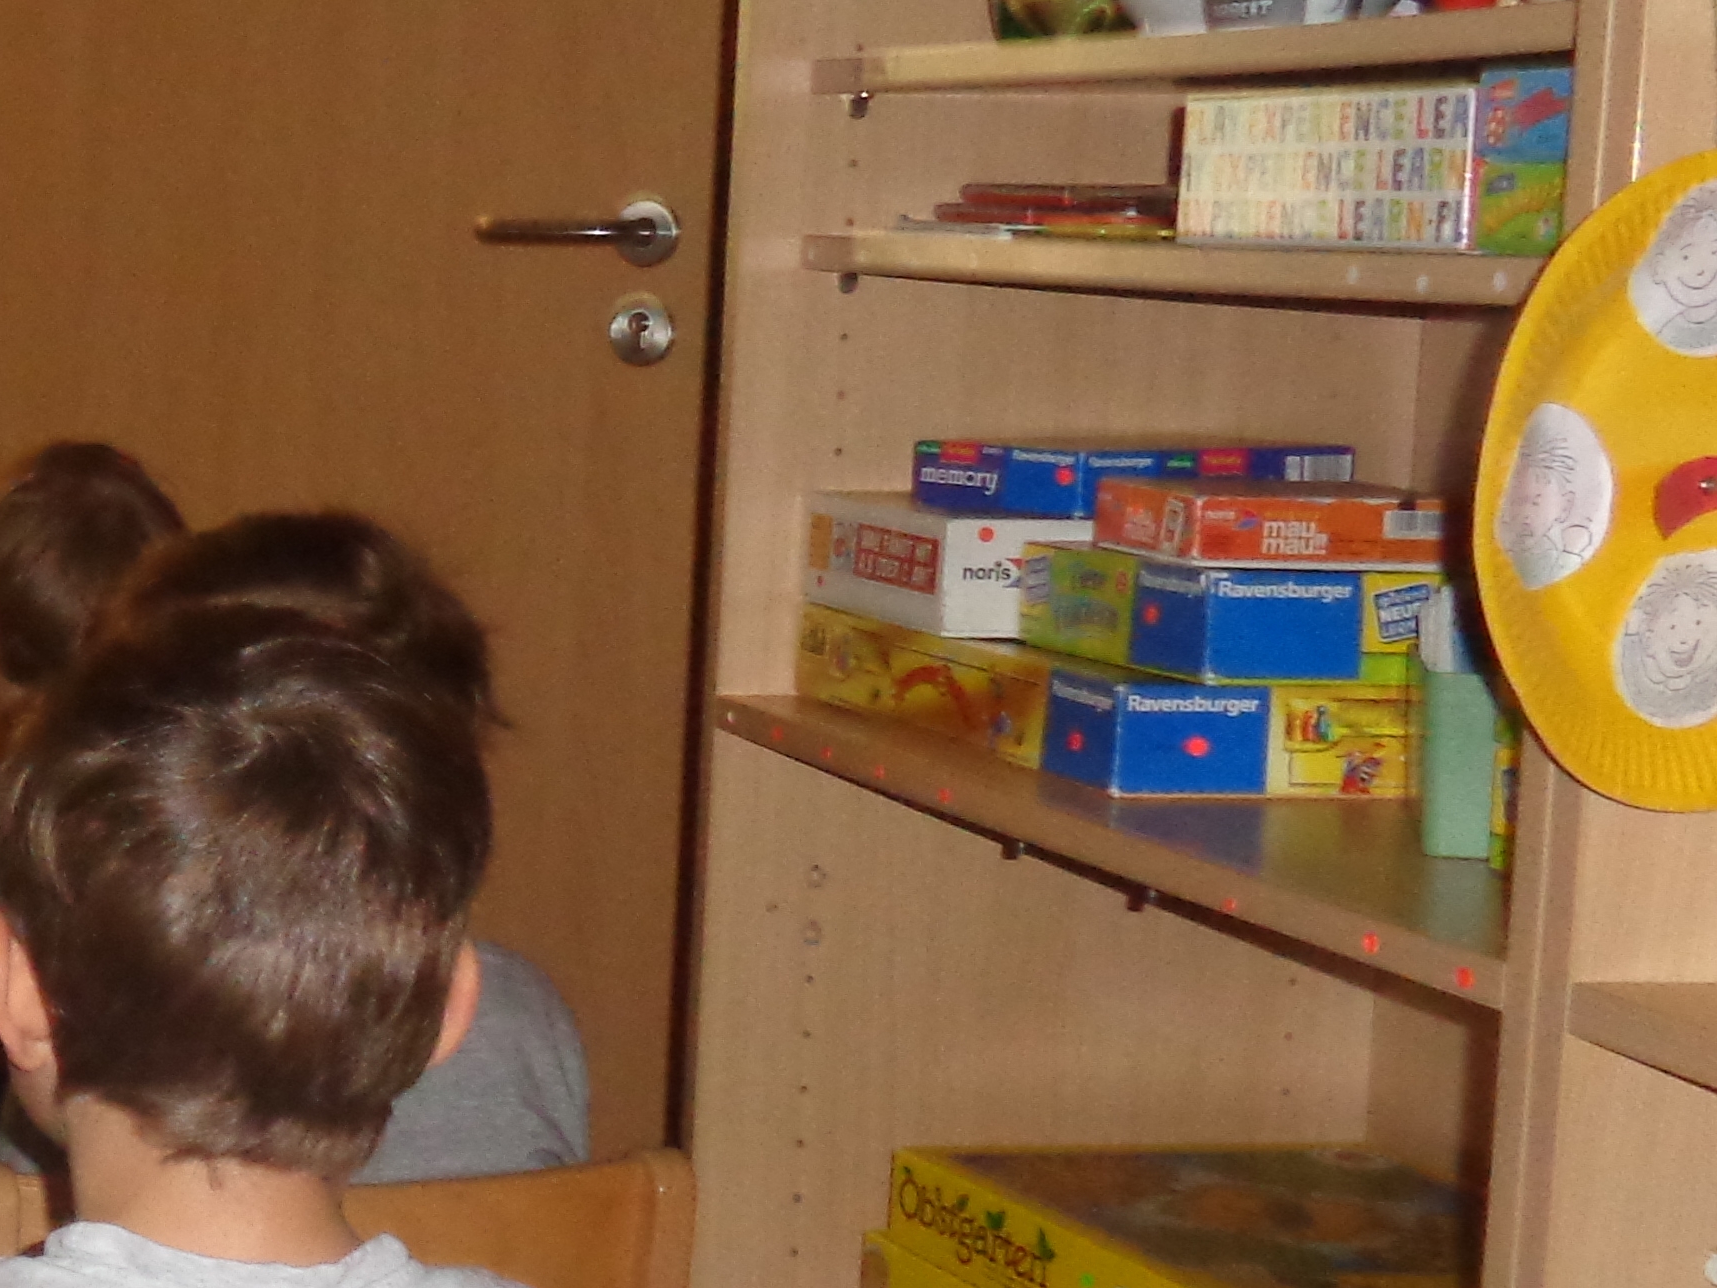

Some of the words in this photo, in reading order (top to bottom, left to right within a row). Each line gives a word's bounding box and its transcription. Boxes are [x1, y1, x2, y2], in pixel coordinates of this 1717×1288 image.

[919, 465, 999, 495] memory
[962, 560, 1013, 582] noris
[1218, 580, 1353, 603] Ravensburger
[1127, 695, 1260, 717] Ravensburger
[898, 1173, 1050, 1288] Obstgarten
